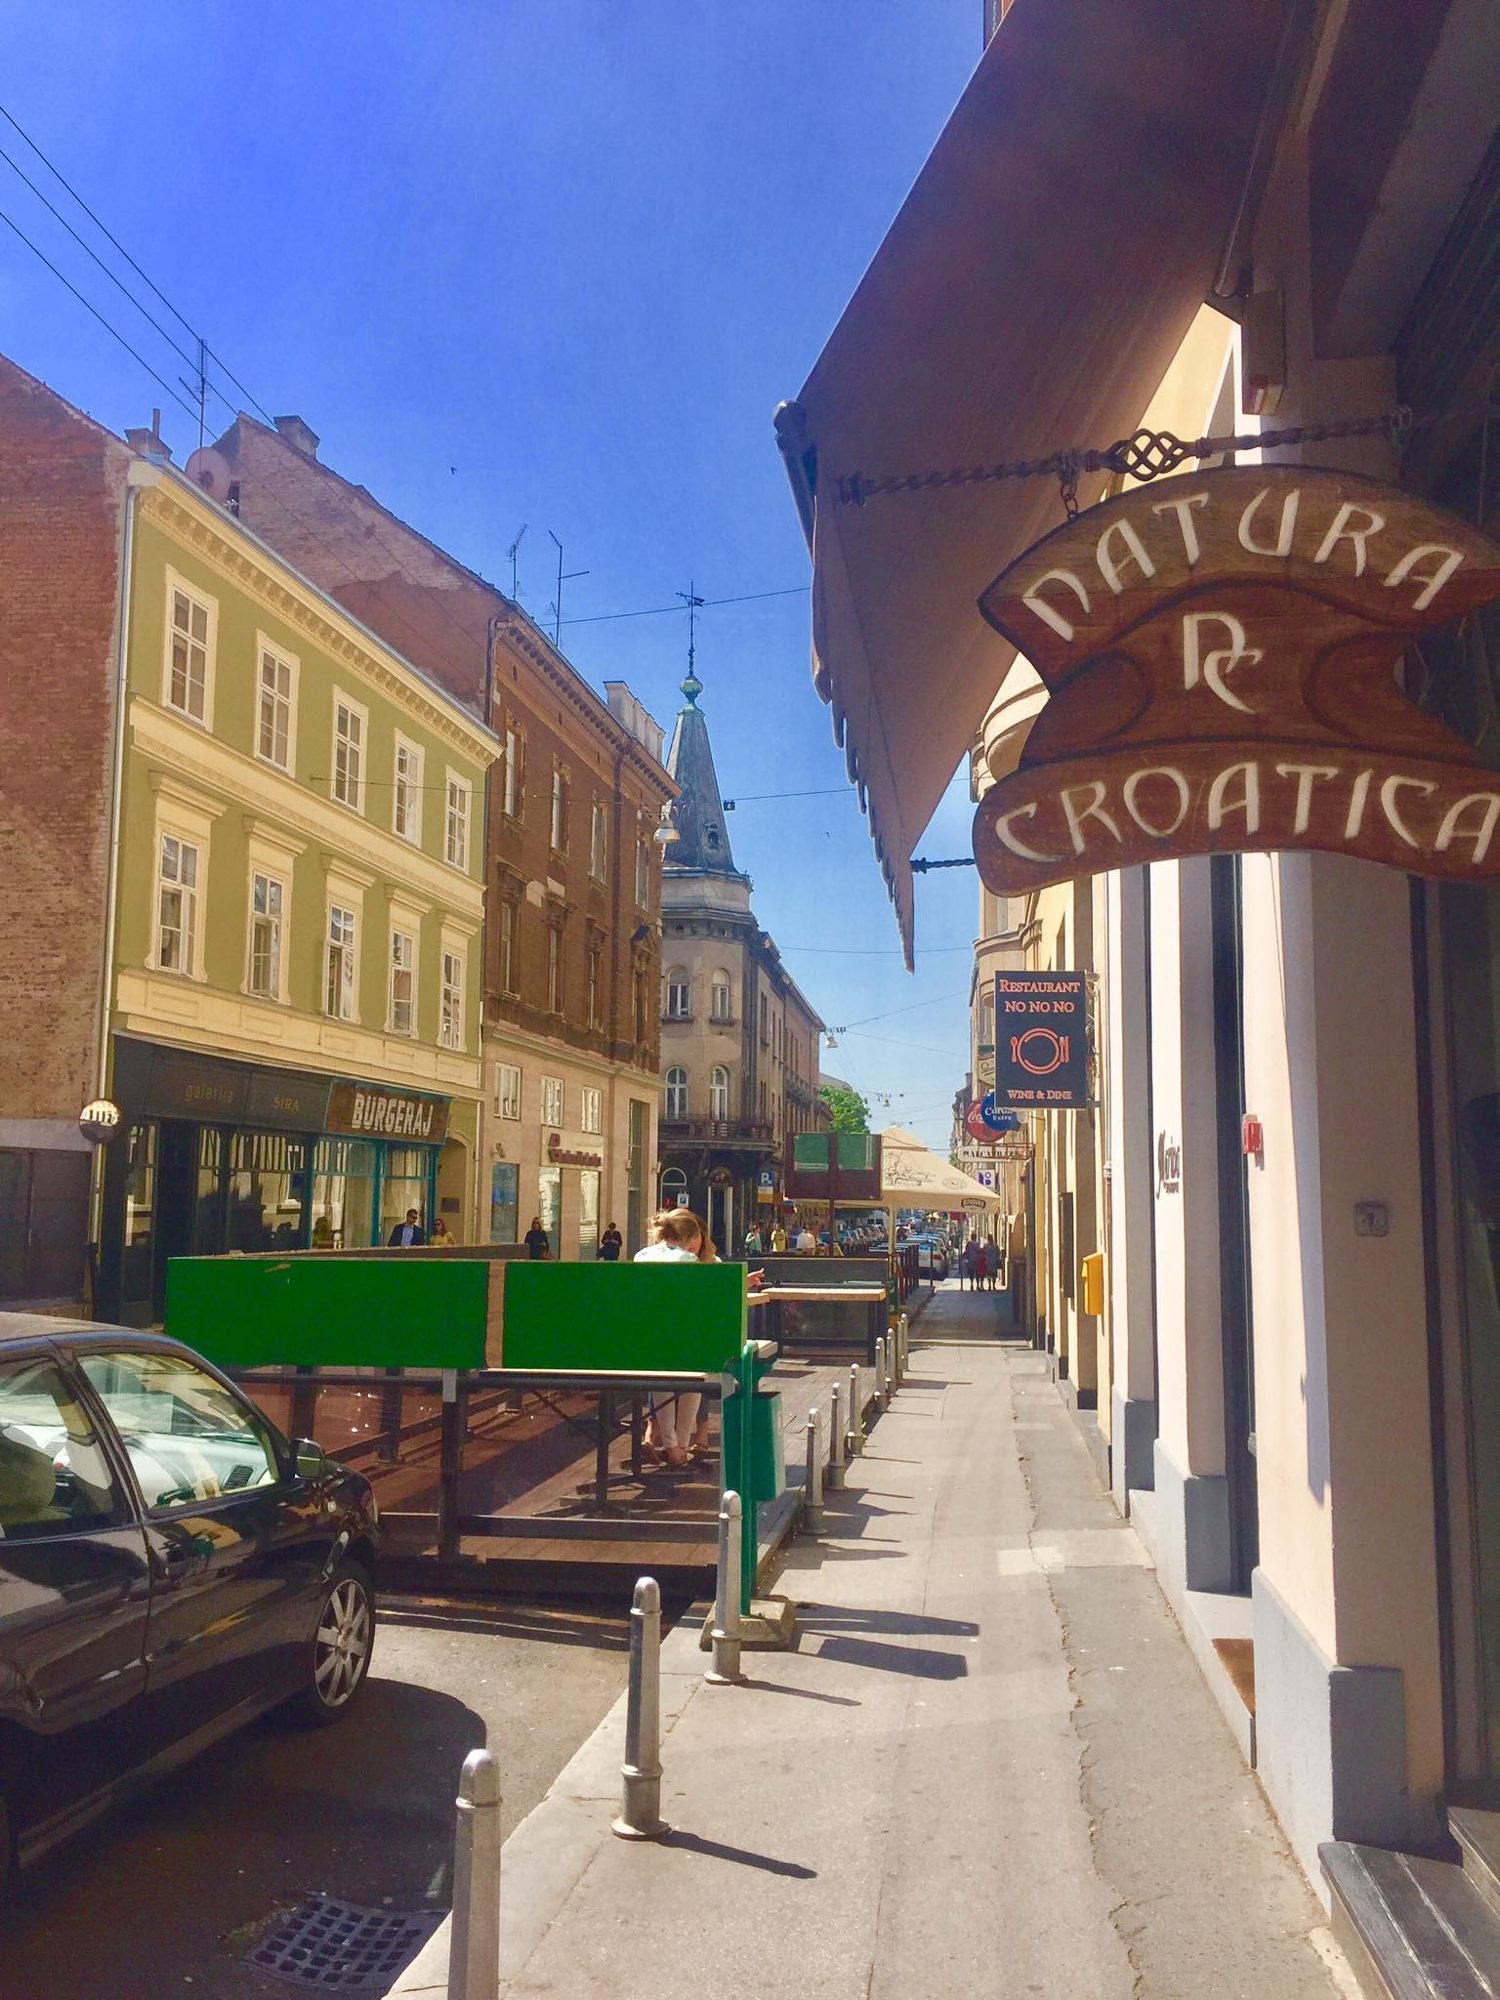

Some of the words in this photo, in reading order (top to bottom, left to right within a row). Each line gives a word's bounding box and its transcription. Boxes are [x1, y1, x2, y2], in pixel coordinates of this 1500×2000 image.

[1021, 487, 1464, 643] NATURA
[995, 761, 1500, 864] CROATICA
[999, 979, 1080, 993] RESTAURANT
[1005, 1001, 1026, 1013] NO
[1029, 1001, 1050, 1013] NO
[1053, 1001, 1075, 1013] NO
[1006, 1089, 1034, 1100] WINE
[1036, 1089, 1045, 1100] &
[1047, 1089, 1073, 1100] DINE
[351, 1092, 434, 1137] BURGERAJ
